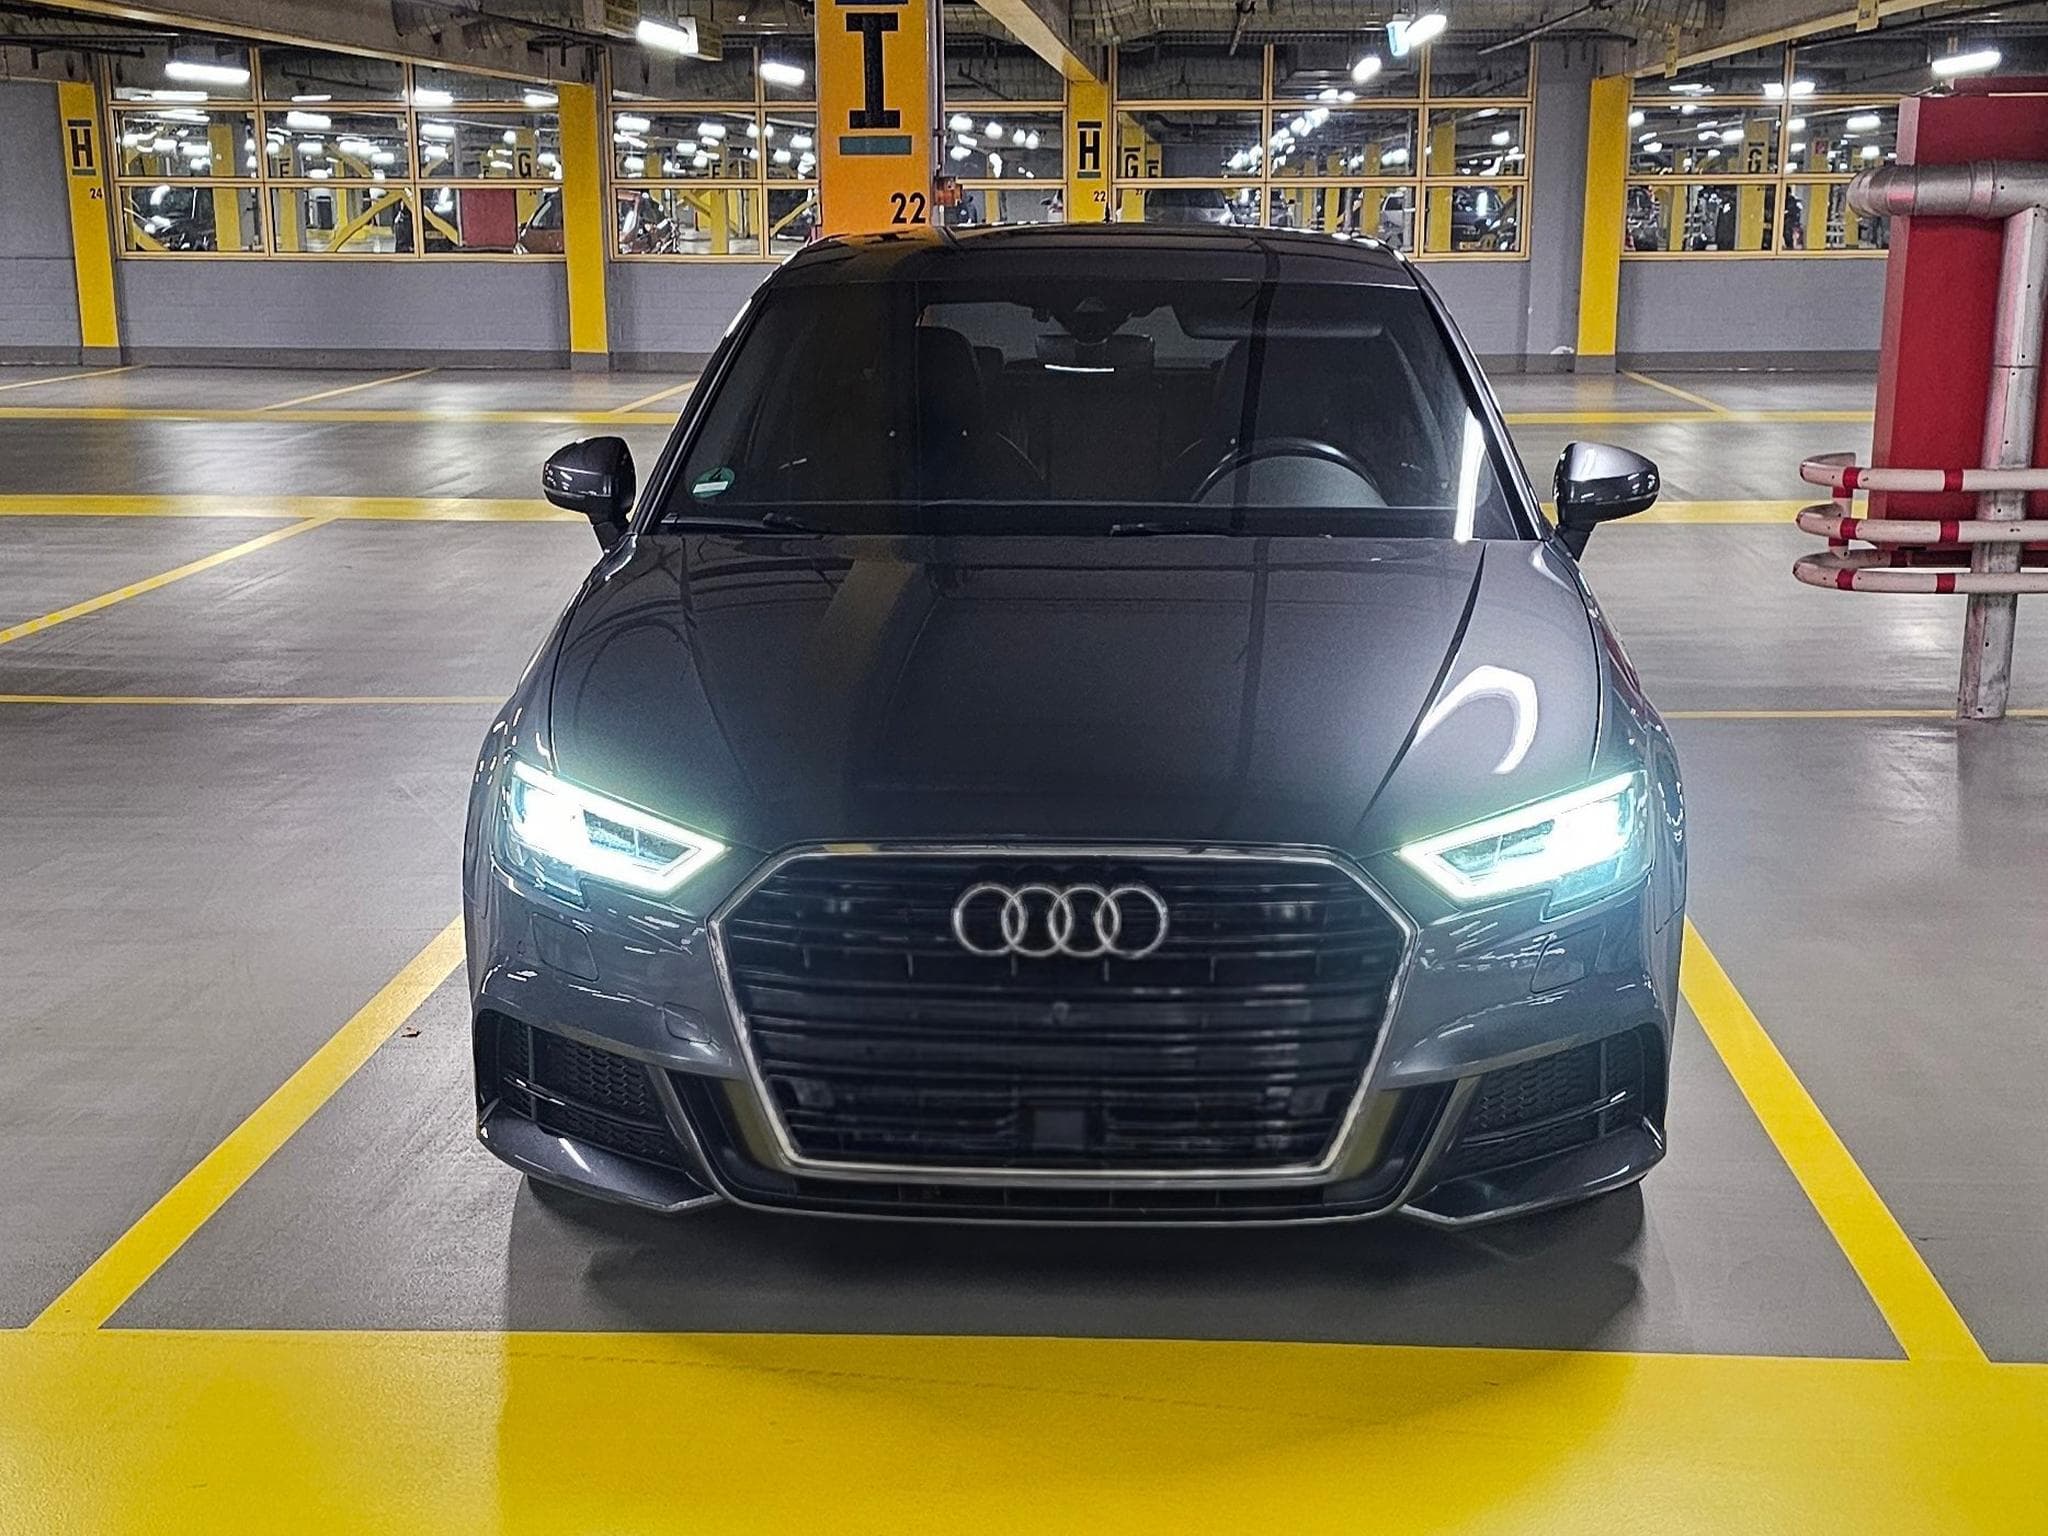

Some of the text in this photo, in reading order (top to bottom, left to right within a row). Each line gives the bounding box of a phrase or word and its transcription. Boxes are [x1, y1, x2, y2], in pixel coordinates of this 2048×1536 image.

[845, 12, 901, 129] I
[70, 128, 94, 167] H
[1079, 130, 1100, 170] H
[518, 152, 531, 177] G
[1125, 154, 1139, 178] G
[90, 187, 103, 200] 24
[1093, 191, 1106, 202] 22
[890, 192, 927, 224] 22
